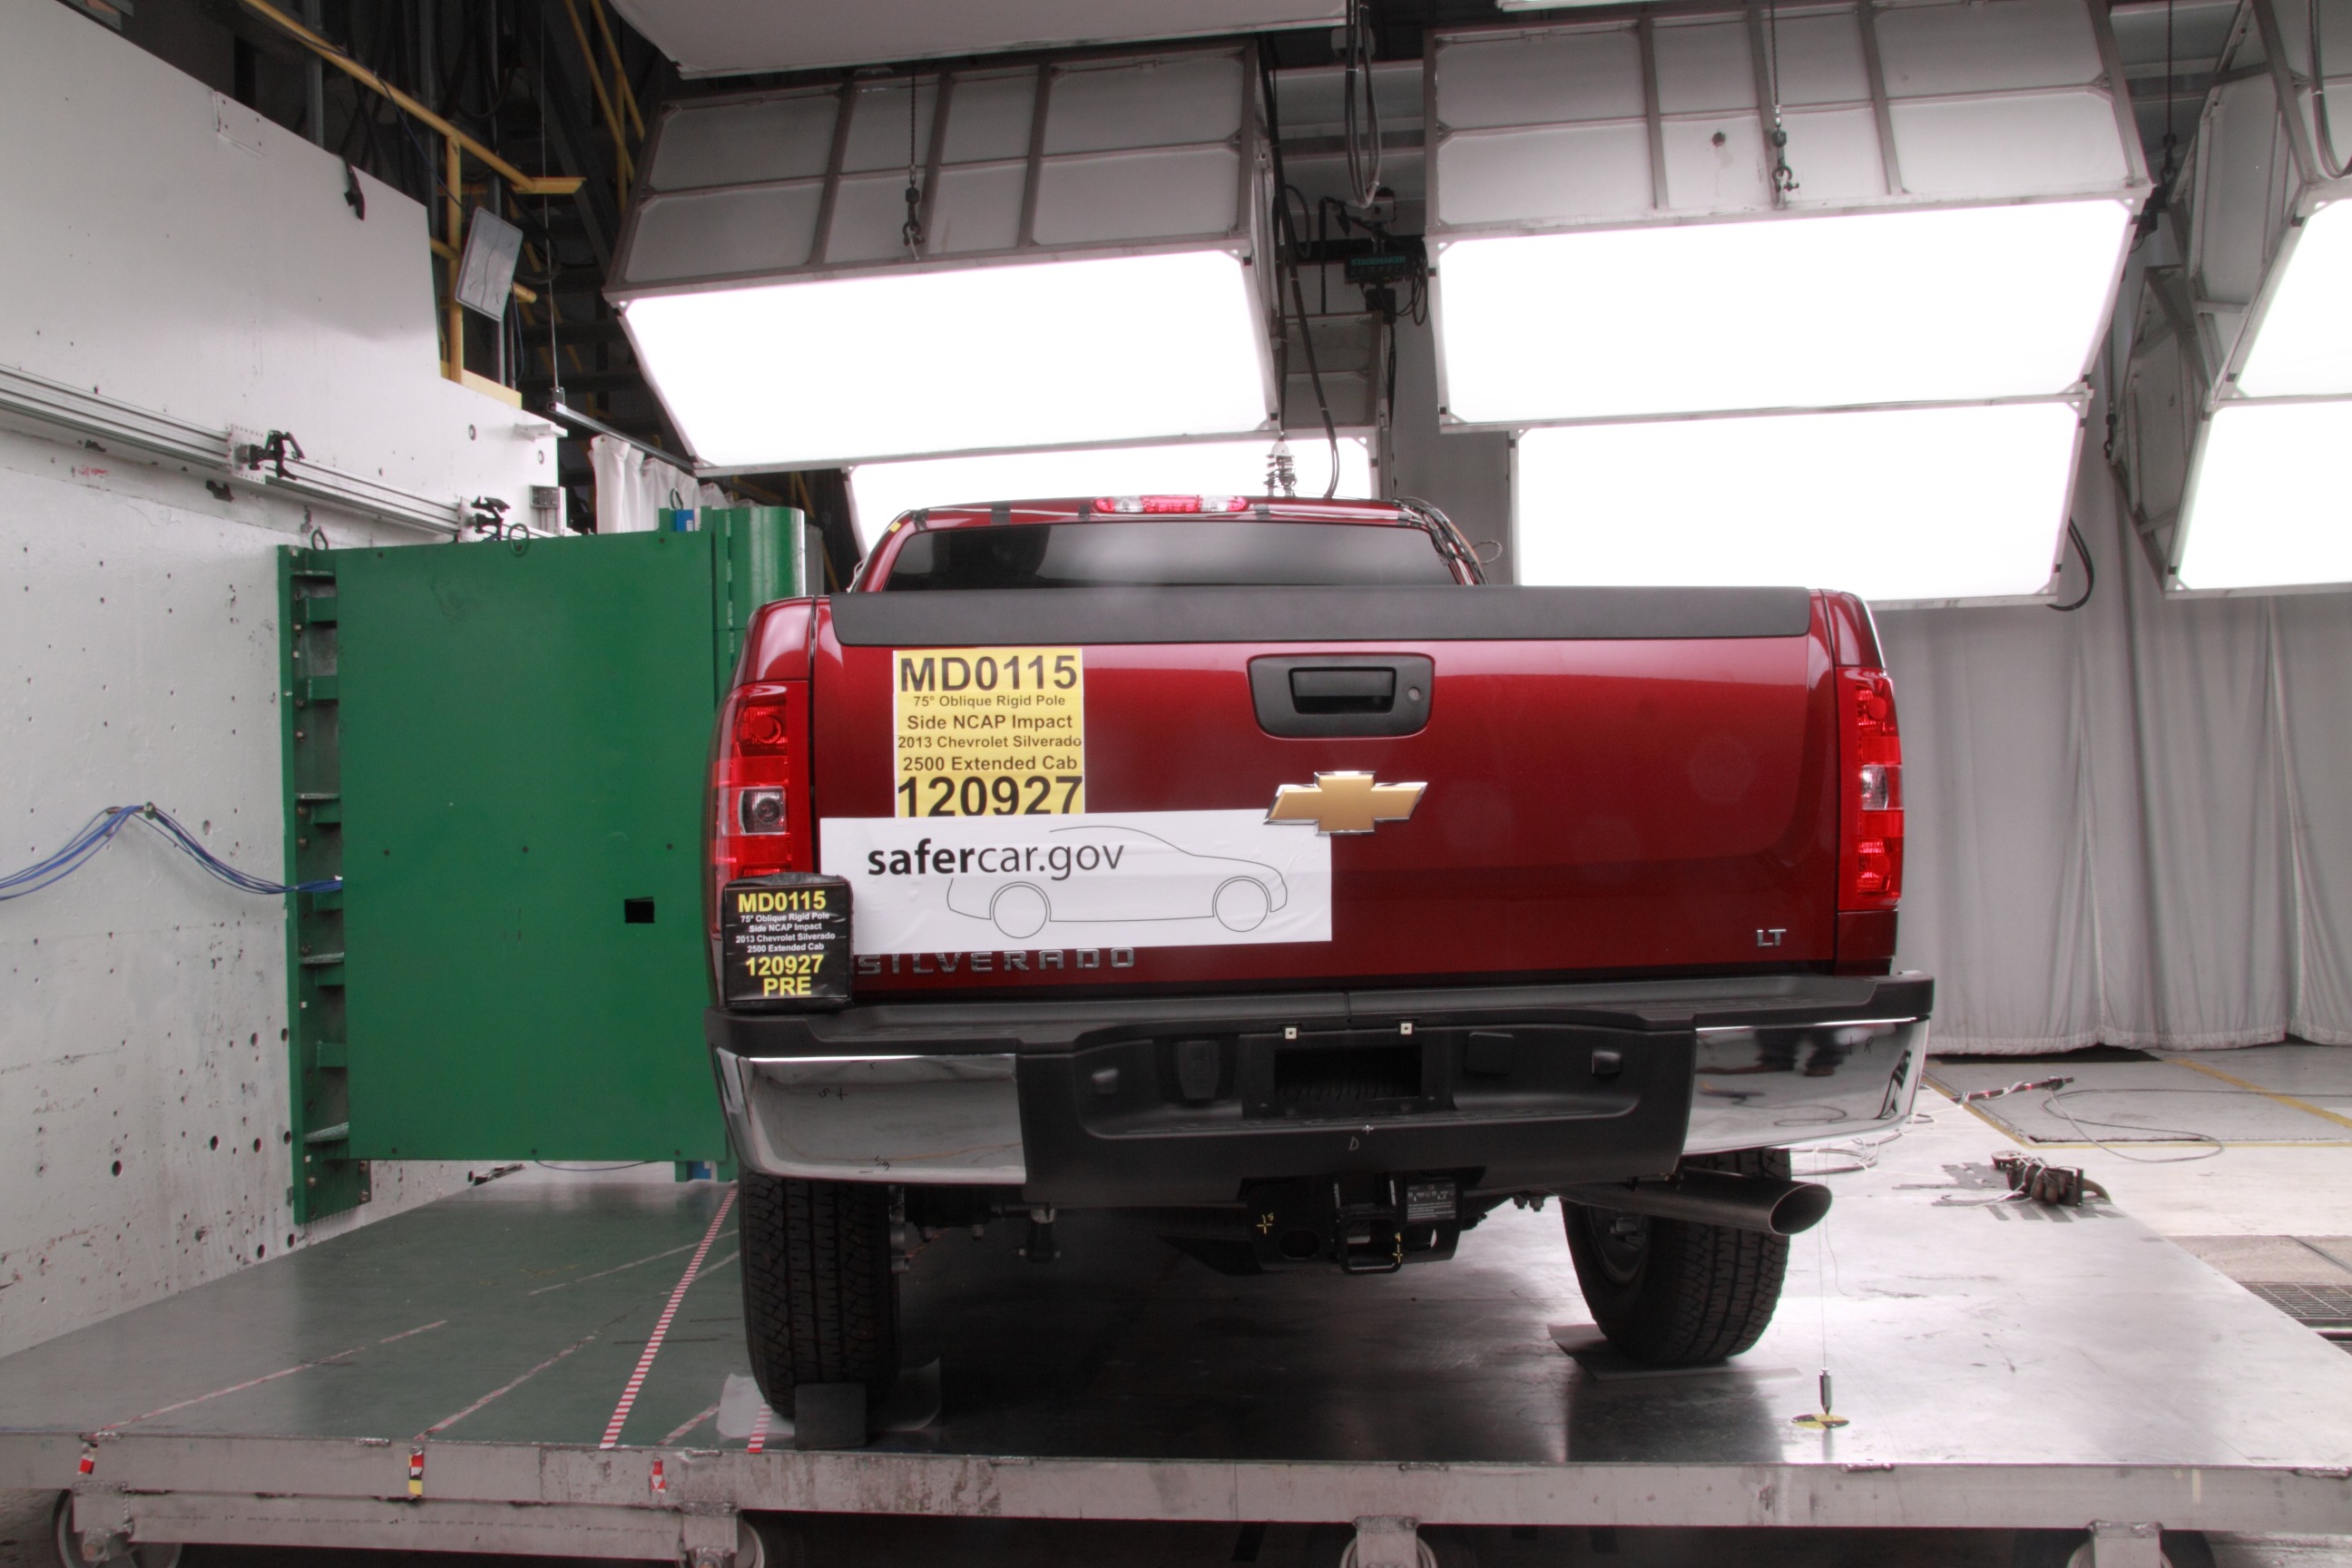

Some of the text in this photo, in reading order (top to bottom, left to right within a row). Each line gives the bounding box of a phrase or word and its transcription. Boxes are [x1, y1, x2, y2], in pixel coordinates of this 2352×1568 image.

[900, 654, 1077, 692] MD0115
[913, 694, 1066, 709] 75° Oblique Rigid Pole
[907, 714, 1073, 731] Side NCAP Impact
[897, 735, 1082, 749] 2013 Chevrolet Silverado
[903, 755, 1078, 771] 2500 Extended Cab
[897, 775, 1083, 818] 120927
[867, 838, 1124, 881] safercar.gov
[738, 890, 827, 913] MD0115
[755, 914, 787, 923] Oblique
[789, 912, 810, 922] Rigid
[811, 912, 829, 920] Pole
[749, 923, 822, 933] Side NCAP Impact
[735, 932, 836, 944] 2013 Chevrolet Silverado
[1756, 928, 1787, 947] LT
[747, 942, 825, 953] 2500 Extended Cab
[745, 955, 824, 976] 120927
[858, 947, 1134, 975] SILVERADO
[763, 976, 811, 997] PRE
